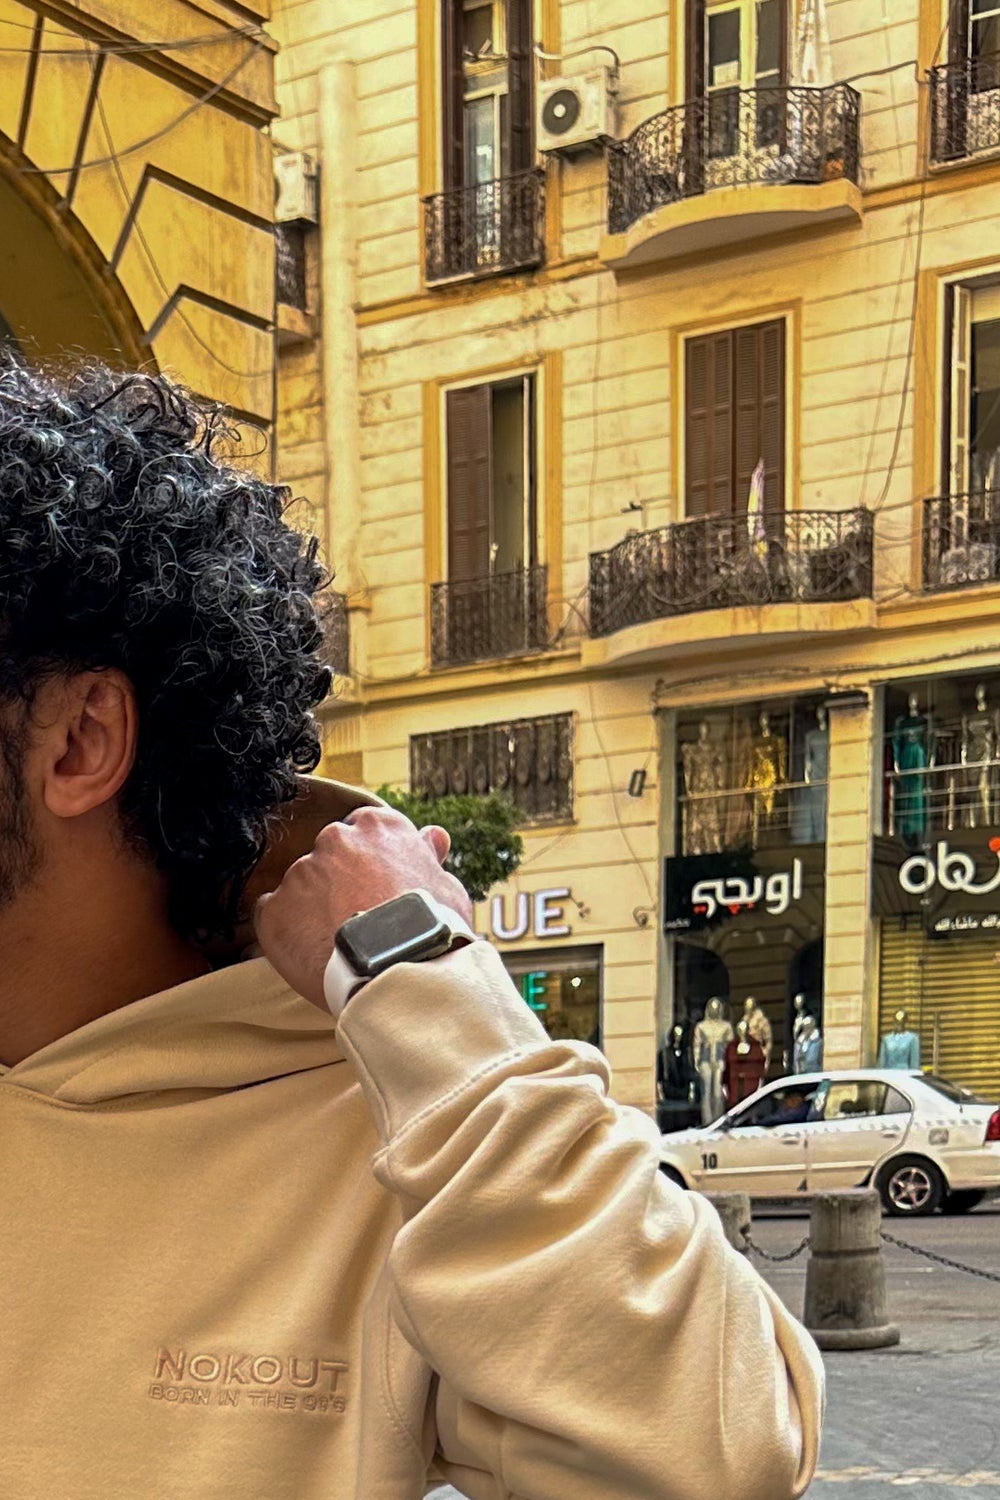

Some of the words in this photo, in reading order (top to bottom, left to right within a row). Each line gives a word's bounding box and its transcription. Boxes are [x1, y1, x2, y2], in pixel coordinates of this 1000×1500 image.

[475, 888, 571, 940] UE
[700, 1153, 718, 1170] 10
[155, 1347, 349, 1392] NOKOUT
[149, 1384, 210, 1405] BORN
[218, 1388, 240, 1407] IN
[247, 1389, 297, 1409] THE
